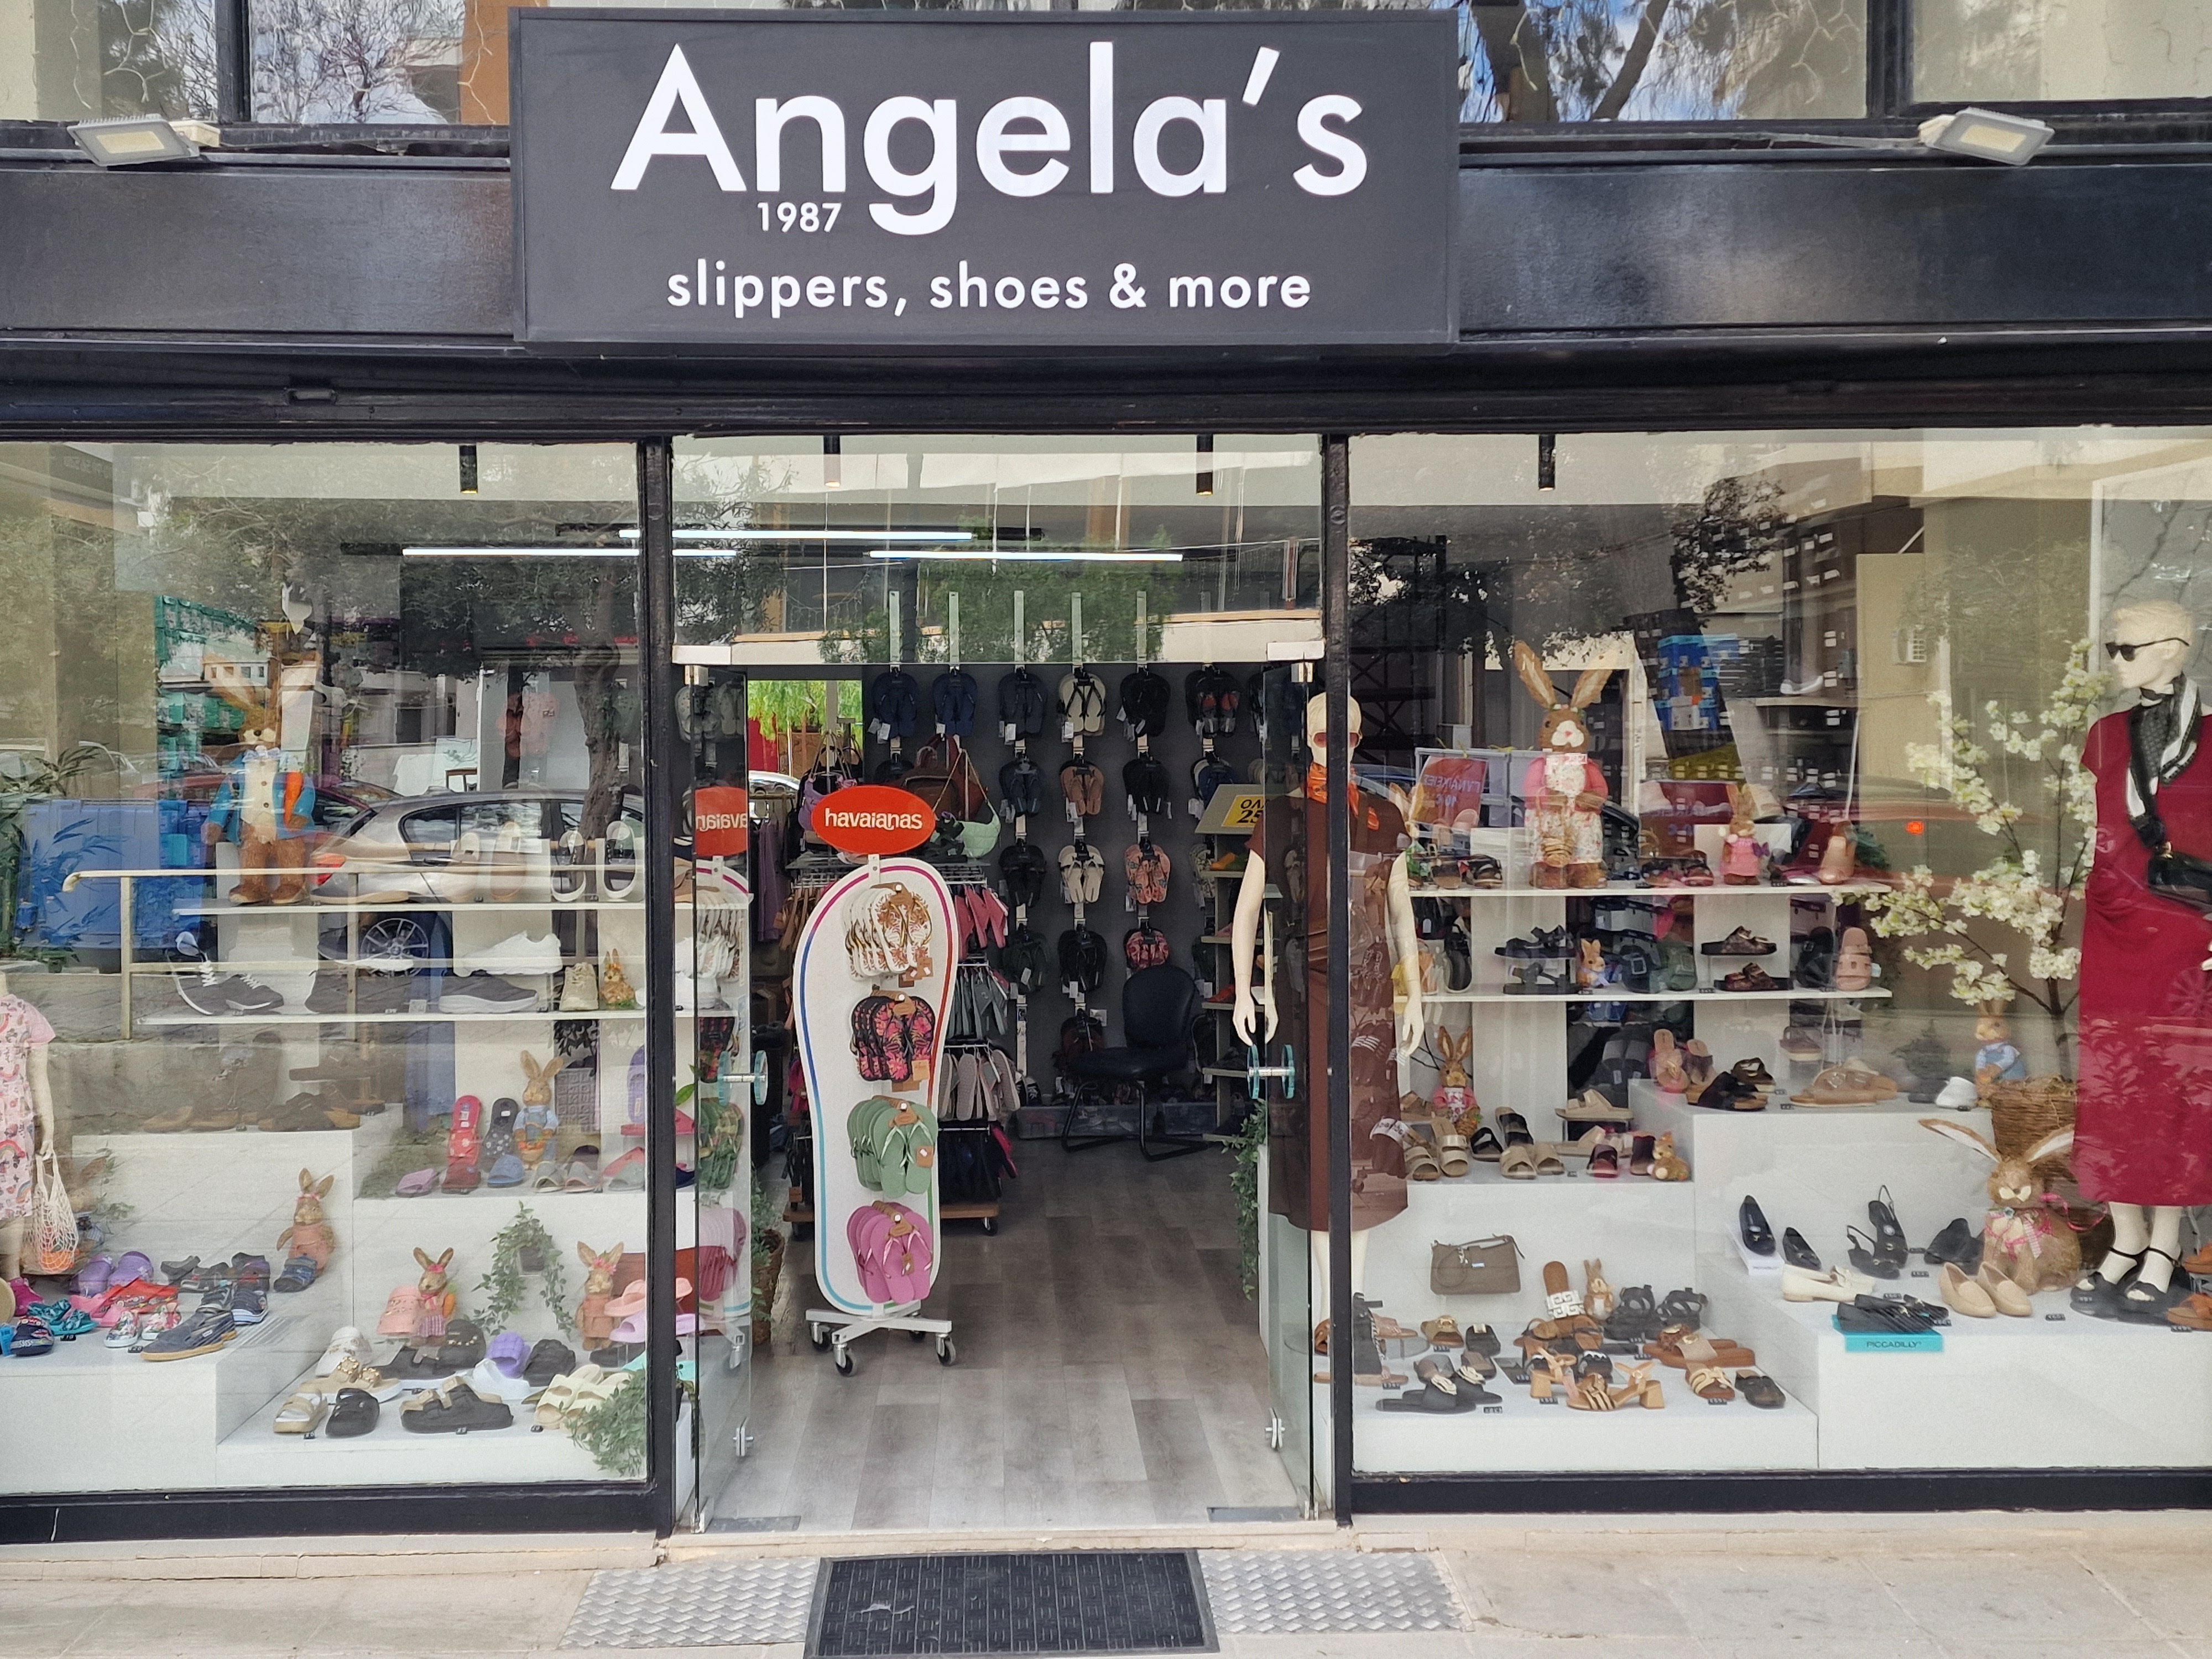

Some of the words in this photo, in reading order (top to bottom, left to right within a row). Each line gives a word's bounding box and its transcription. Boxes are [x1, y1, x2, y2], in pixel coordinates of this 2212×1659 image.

[611, 40, 1368, 236] Angela's
[757, 201, 842, 233] 1987
[667, 258, 907, 319] slippers,
[930, 260, 1088, 309] shoes
[1109, 263, 1146, 309] &
[1169, 275, 1311, 309] more
[825, 807, 923, 831] havaianas
